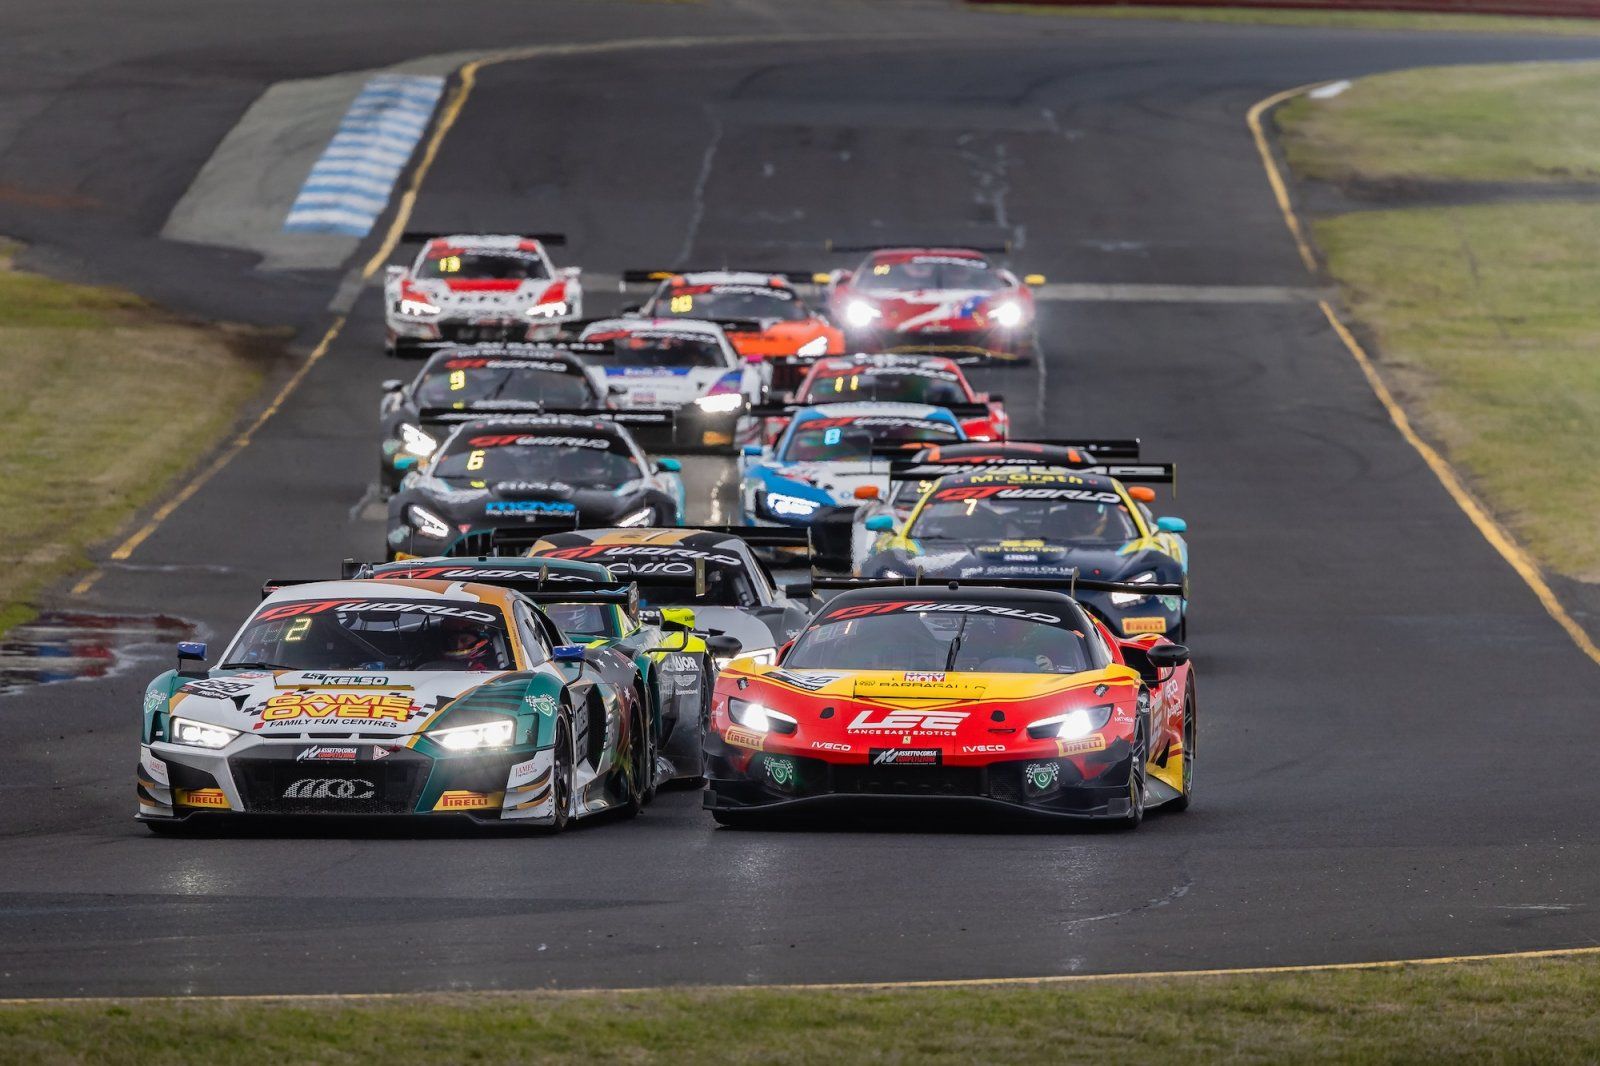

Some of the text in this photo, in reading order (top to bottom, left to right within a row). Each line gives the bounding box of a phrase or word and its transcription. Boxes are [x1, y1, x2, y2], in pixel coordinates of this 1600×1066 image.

[467, 450, 485, 471] 6
[964, 499, 978, 516] 7
[285, 617, 312, 641] 2
[321, 676, 389, 686] KELSO
[267, 693, 414, 707] GAME
[262, 703, 410, 723] OVER
[846, 709, 971, 730] LEE
[269, 718, 313, 728] FAMILY
[341, 718, 398, 728] CENTRES
[727, 729, 760, 748] PIRELLI
[811, 740, 851, 751] IVECO
[1062, 737, 1103, 753] PIRELLI
[962, 744, 1006, 753] IVECO
[186, 792, 224, 804] PIRELLI
[442, 793, 488, 807] PIRELLI
